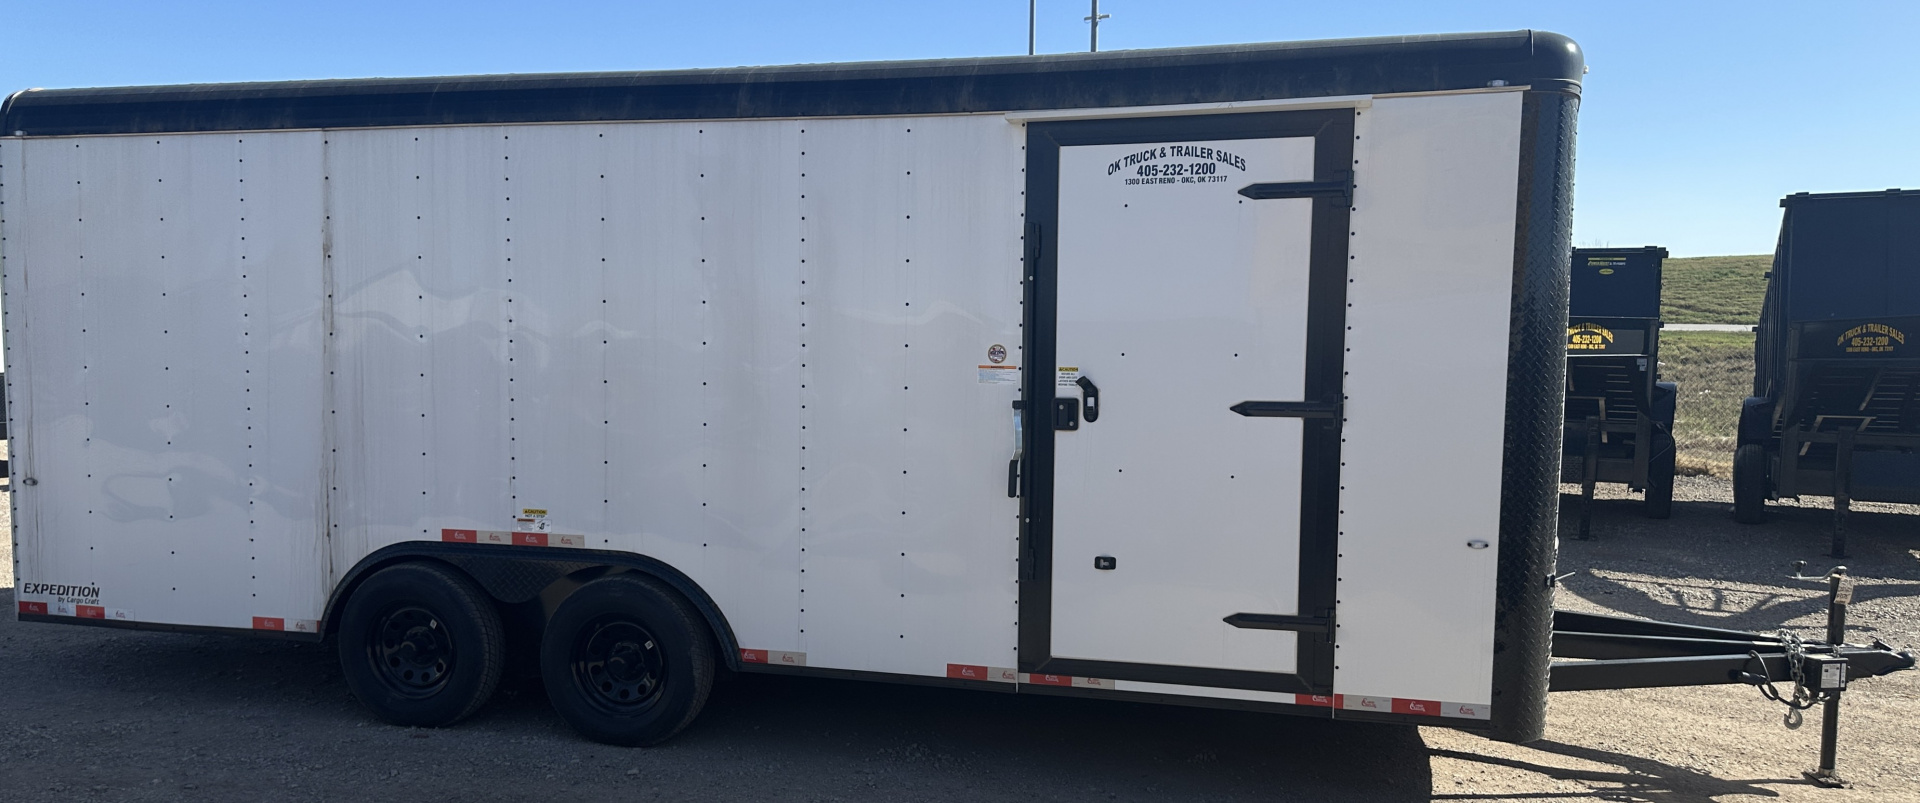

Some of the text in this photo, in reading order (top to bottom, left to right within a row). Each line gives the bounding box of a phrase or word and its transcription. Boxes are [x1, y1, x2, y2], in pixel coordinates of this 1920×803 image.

[1108, 146, 1246, 176] OK TRUCK & TRAILER SALES
[1136, 162, 1216, 177] 405-232-1200
[1181, 176, 1196, 184] OKC,
[1845, 326, 1862, 340] TRUCK
[1868, 324, 1889, 335] TRAILER
[1889, 327, 1904, 344] SALES
[24, 582, 100, 598] EXPEDITION
